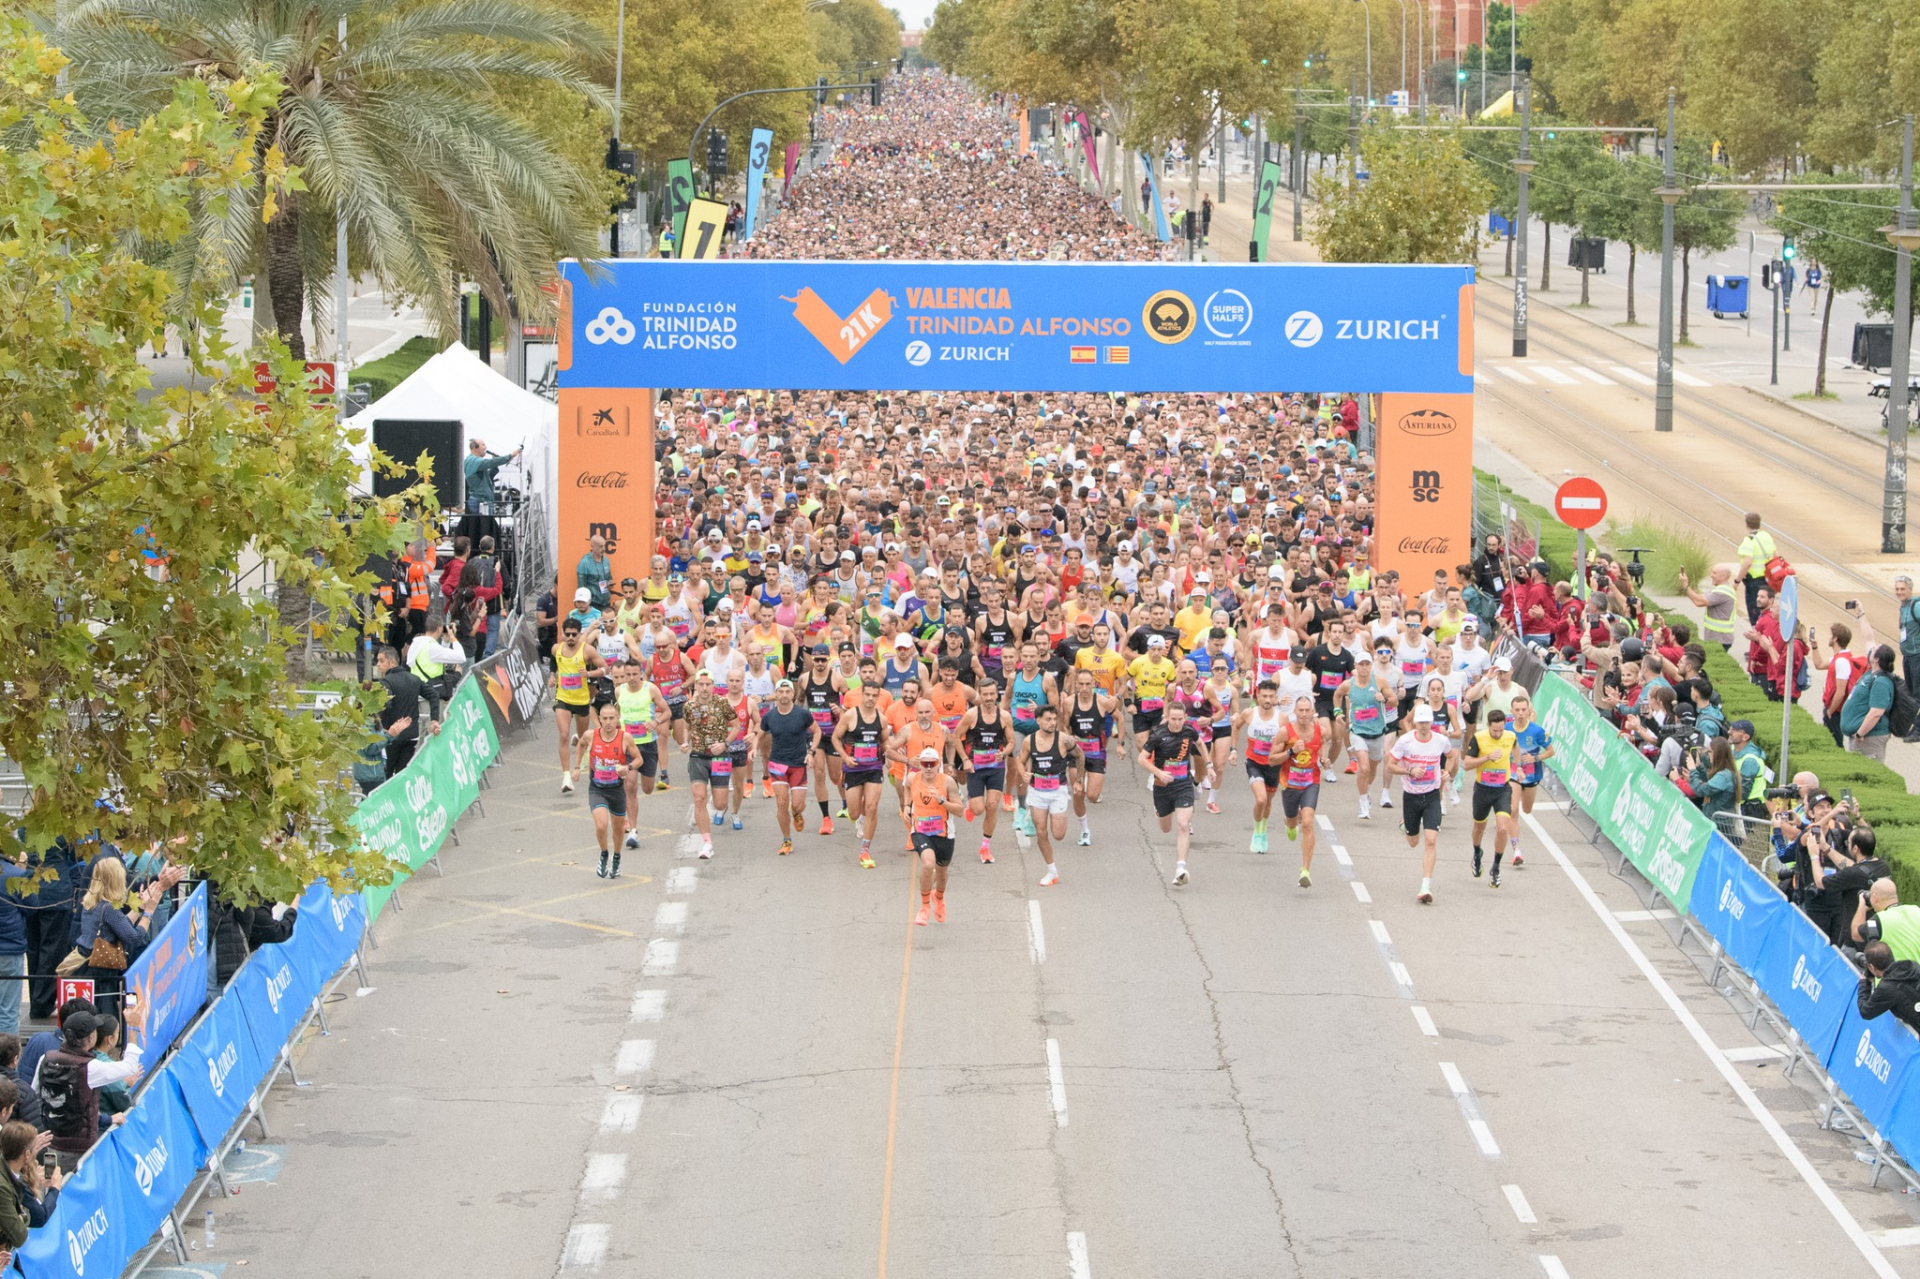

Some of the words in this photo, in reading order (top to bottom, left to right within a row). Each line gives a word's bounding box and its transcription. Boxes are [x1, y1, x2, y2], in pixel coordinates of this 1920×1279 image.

[752, 142, 768, 170] 3
[1259, 179, 1274, 216] 2
[693, 221, 716, 259] 1
[643, 301, 736, 313] FUNDACIÓN
[906, 287, 1012, 310] VALENCIA
[1212, 314, 1244, 322] HALFS
[1213, 305, 1244, 314] SUPER
[642, 316, 737, 332] TRINIDAD
[840, 302, 882, 351] 21K
[906, 316, 1015, 335] TRINIDAD
[1019, 317, 1131, 336] ALFONSO
[1335, 319, 1439, 340] ZURICH
[642, 334, 737, 350] ALFONSO
[938, 346, 1010, 361] ZURICH
[586, 428, 620, 436] CaixaBank
[1403, 419, 1452, 430] ASTURIANA
[577, 471, 629, 488] Coca-Cola
[1413, 470, 1440, 488] m
[1413, 488, 1440, 503] sc
[590, 523, 617, 541] m
[1398, 537, 1450, 554] Coca-Cola
[1015, 691, 1038, 700] CRESPO
[1638, 773, 1663, 804] FUNDACIÓN
[1629, 792, 1655, 831] TRINIDAD
[1619, 819, 1646, 856] ALFONSO
[217, 1040, 238, 1082] ZURICH
[1864, 1044, 1891, 1085] ZURICH
[145, 1135, 168, 1178] ZURH
[77, 1205, 109, 1256] ZURICH
